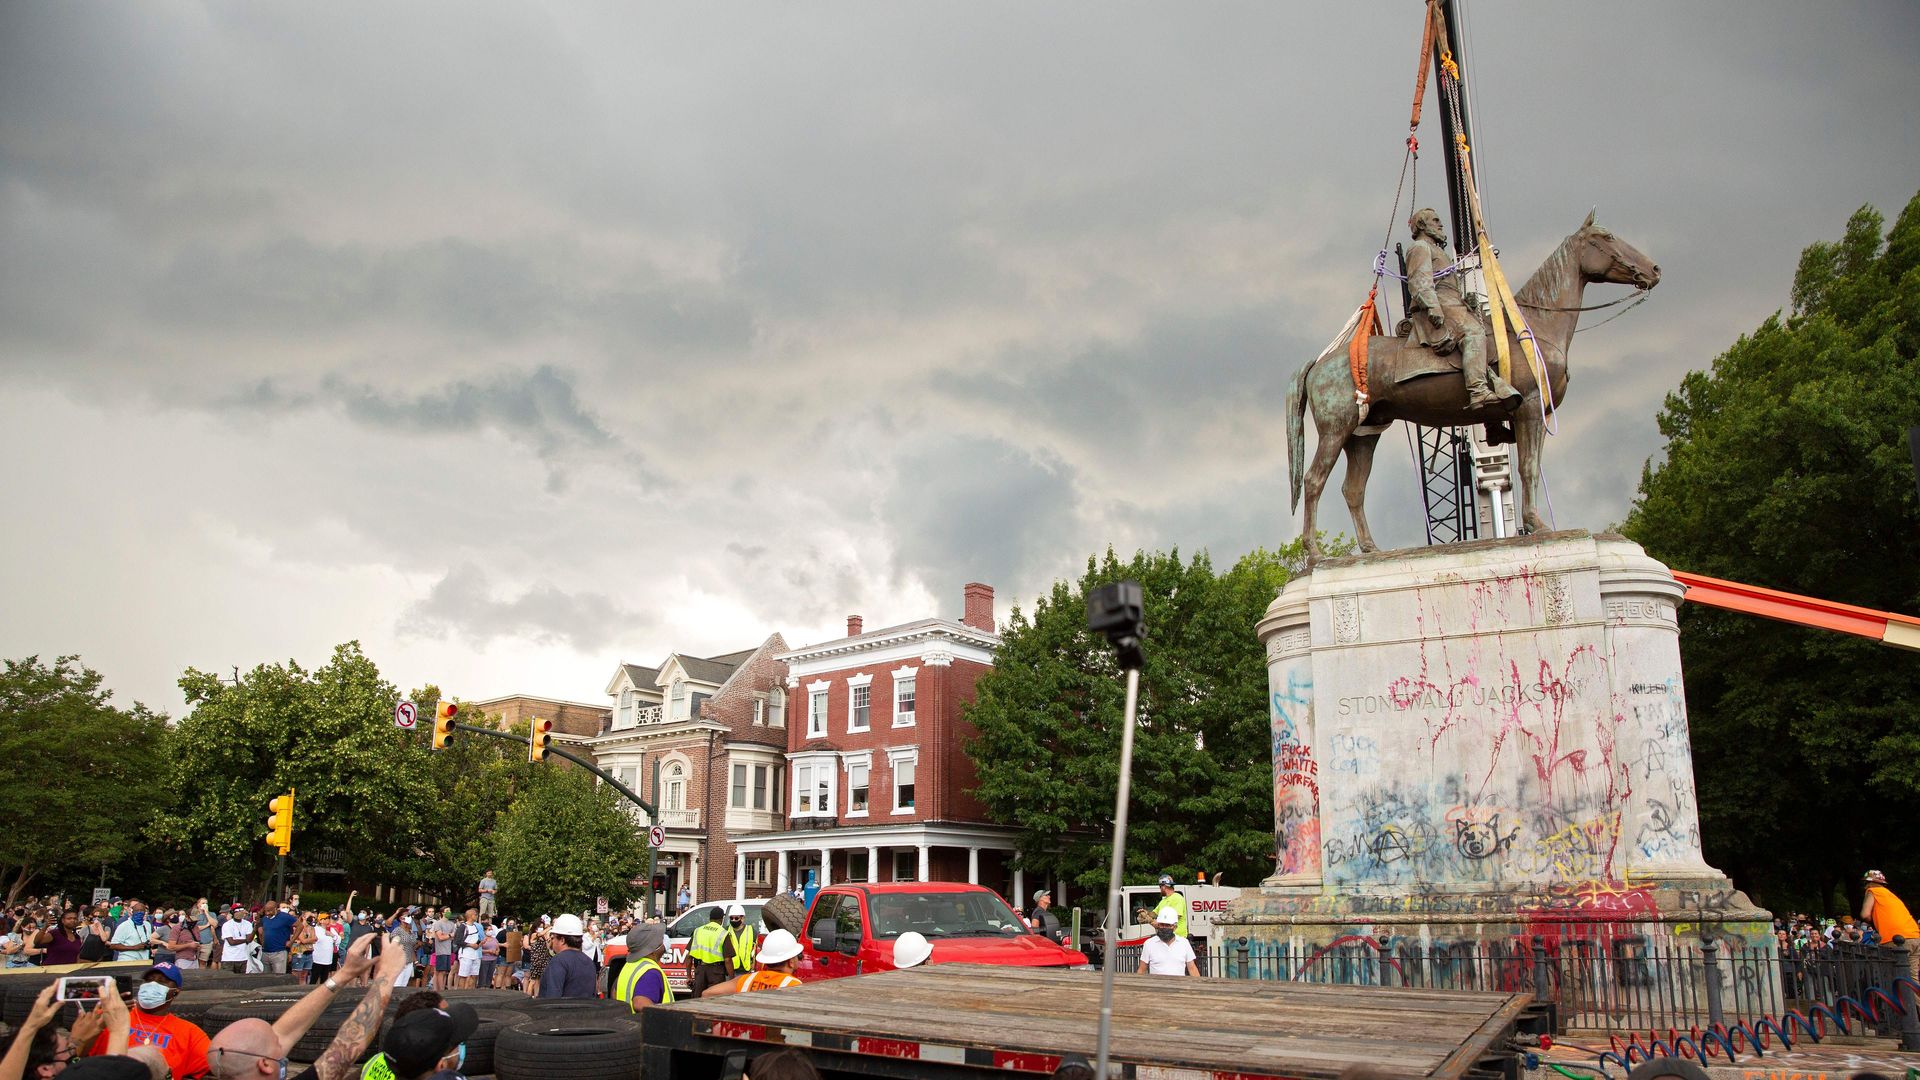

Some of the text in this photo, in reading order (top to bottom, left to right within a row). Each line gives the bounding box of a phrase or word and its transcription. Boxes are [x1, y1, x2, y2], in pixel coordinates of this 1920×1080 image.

[1338, 680, 1583, 716] STONEWALL JACKSON
[1281, 743, 1311, 757] FUCK
[1282, 758, 1318, 776] WHITE
[1191, 900, 1231, 912] SME
